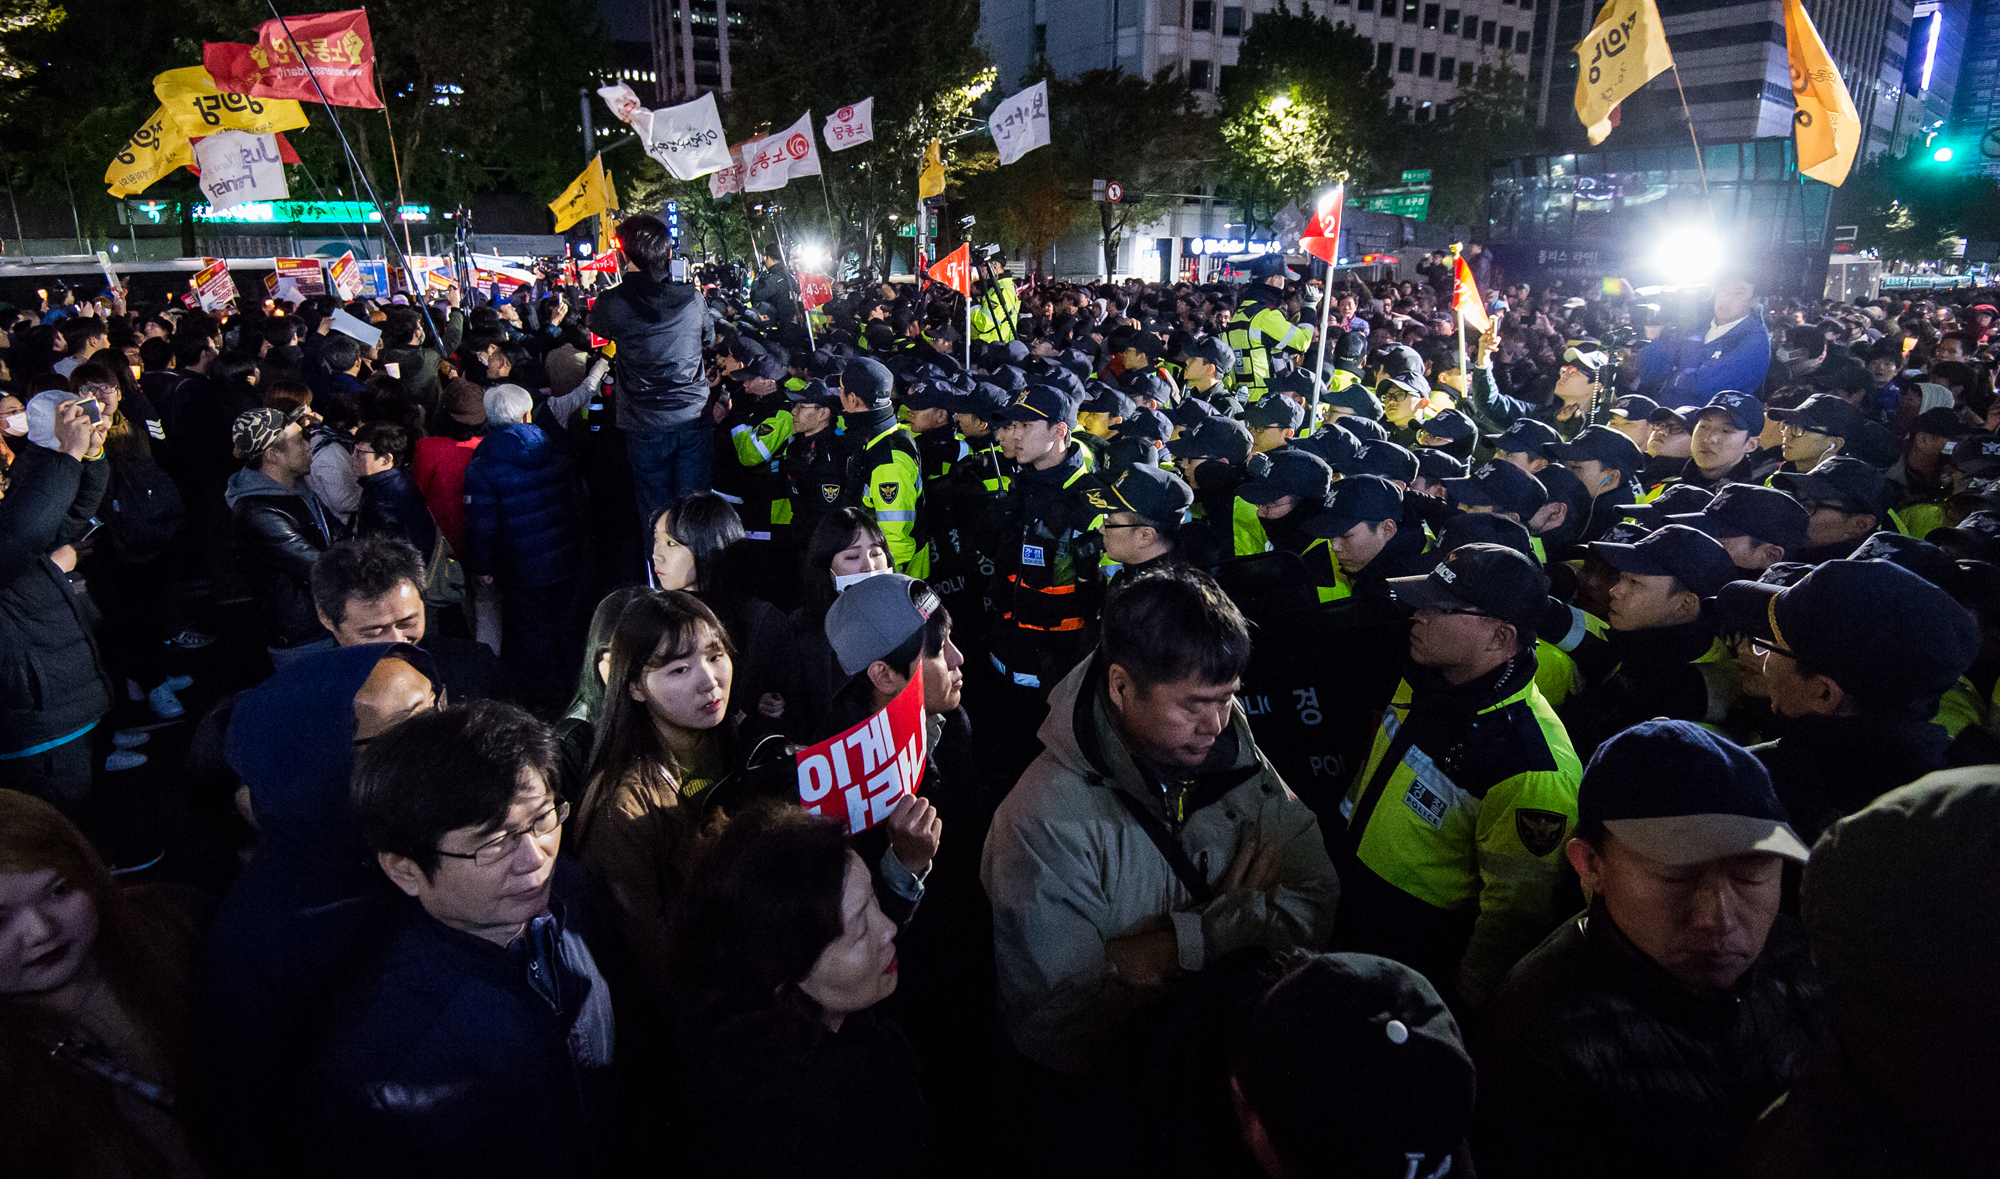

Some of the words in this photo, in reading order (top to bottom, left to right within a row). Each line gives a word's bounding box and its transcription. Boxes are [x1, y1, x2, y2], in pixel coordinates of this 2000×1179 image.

[934, 575, 966, 596] POLI
[1292, 687, 1323, 726] 경
[797, 707, 897, 803] 이게
[1405, 796, 1438, 825] POLICE
[1413, 781, 1444, 816] 경찰
